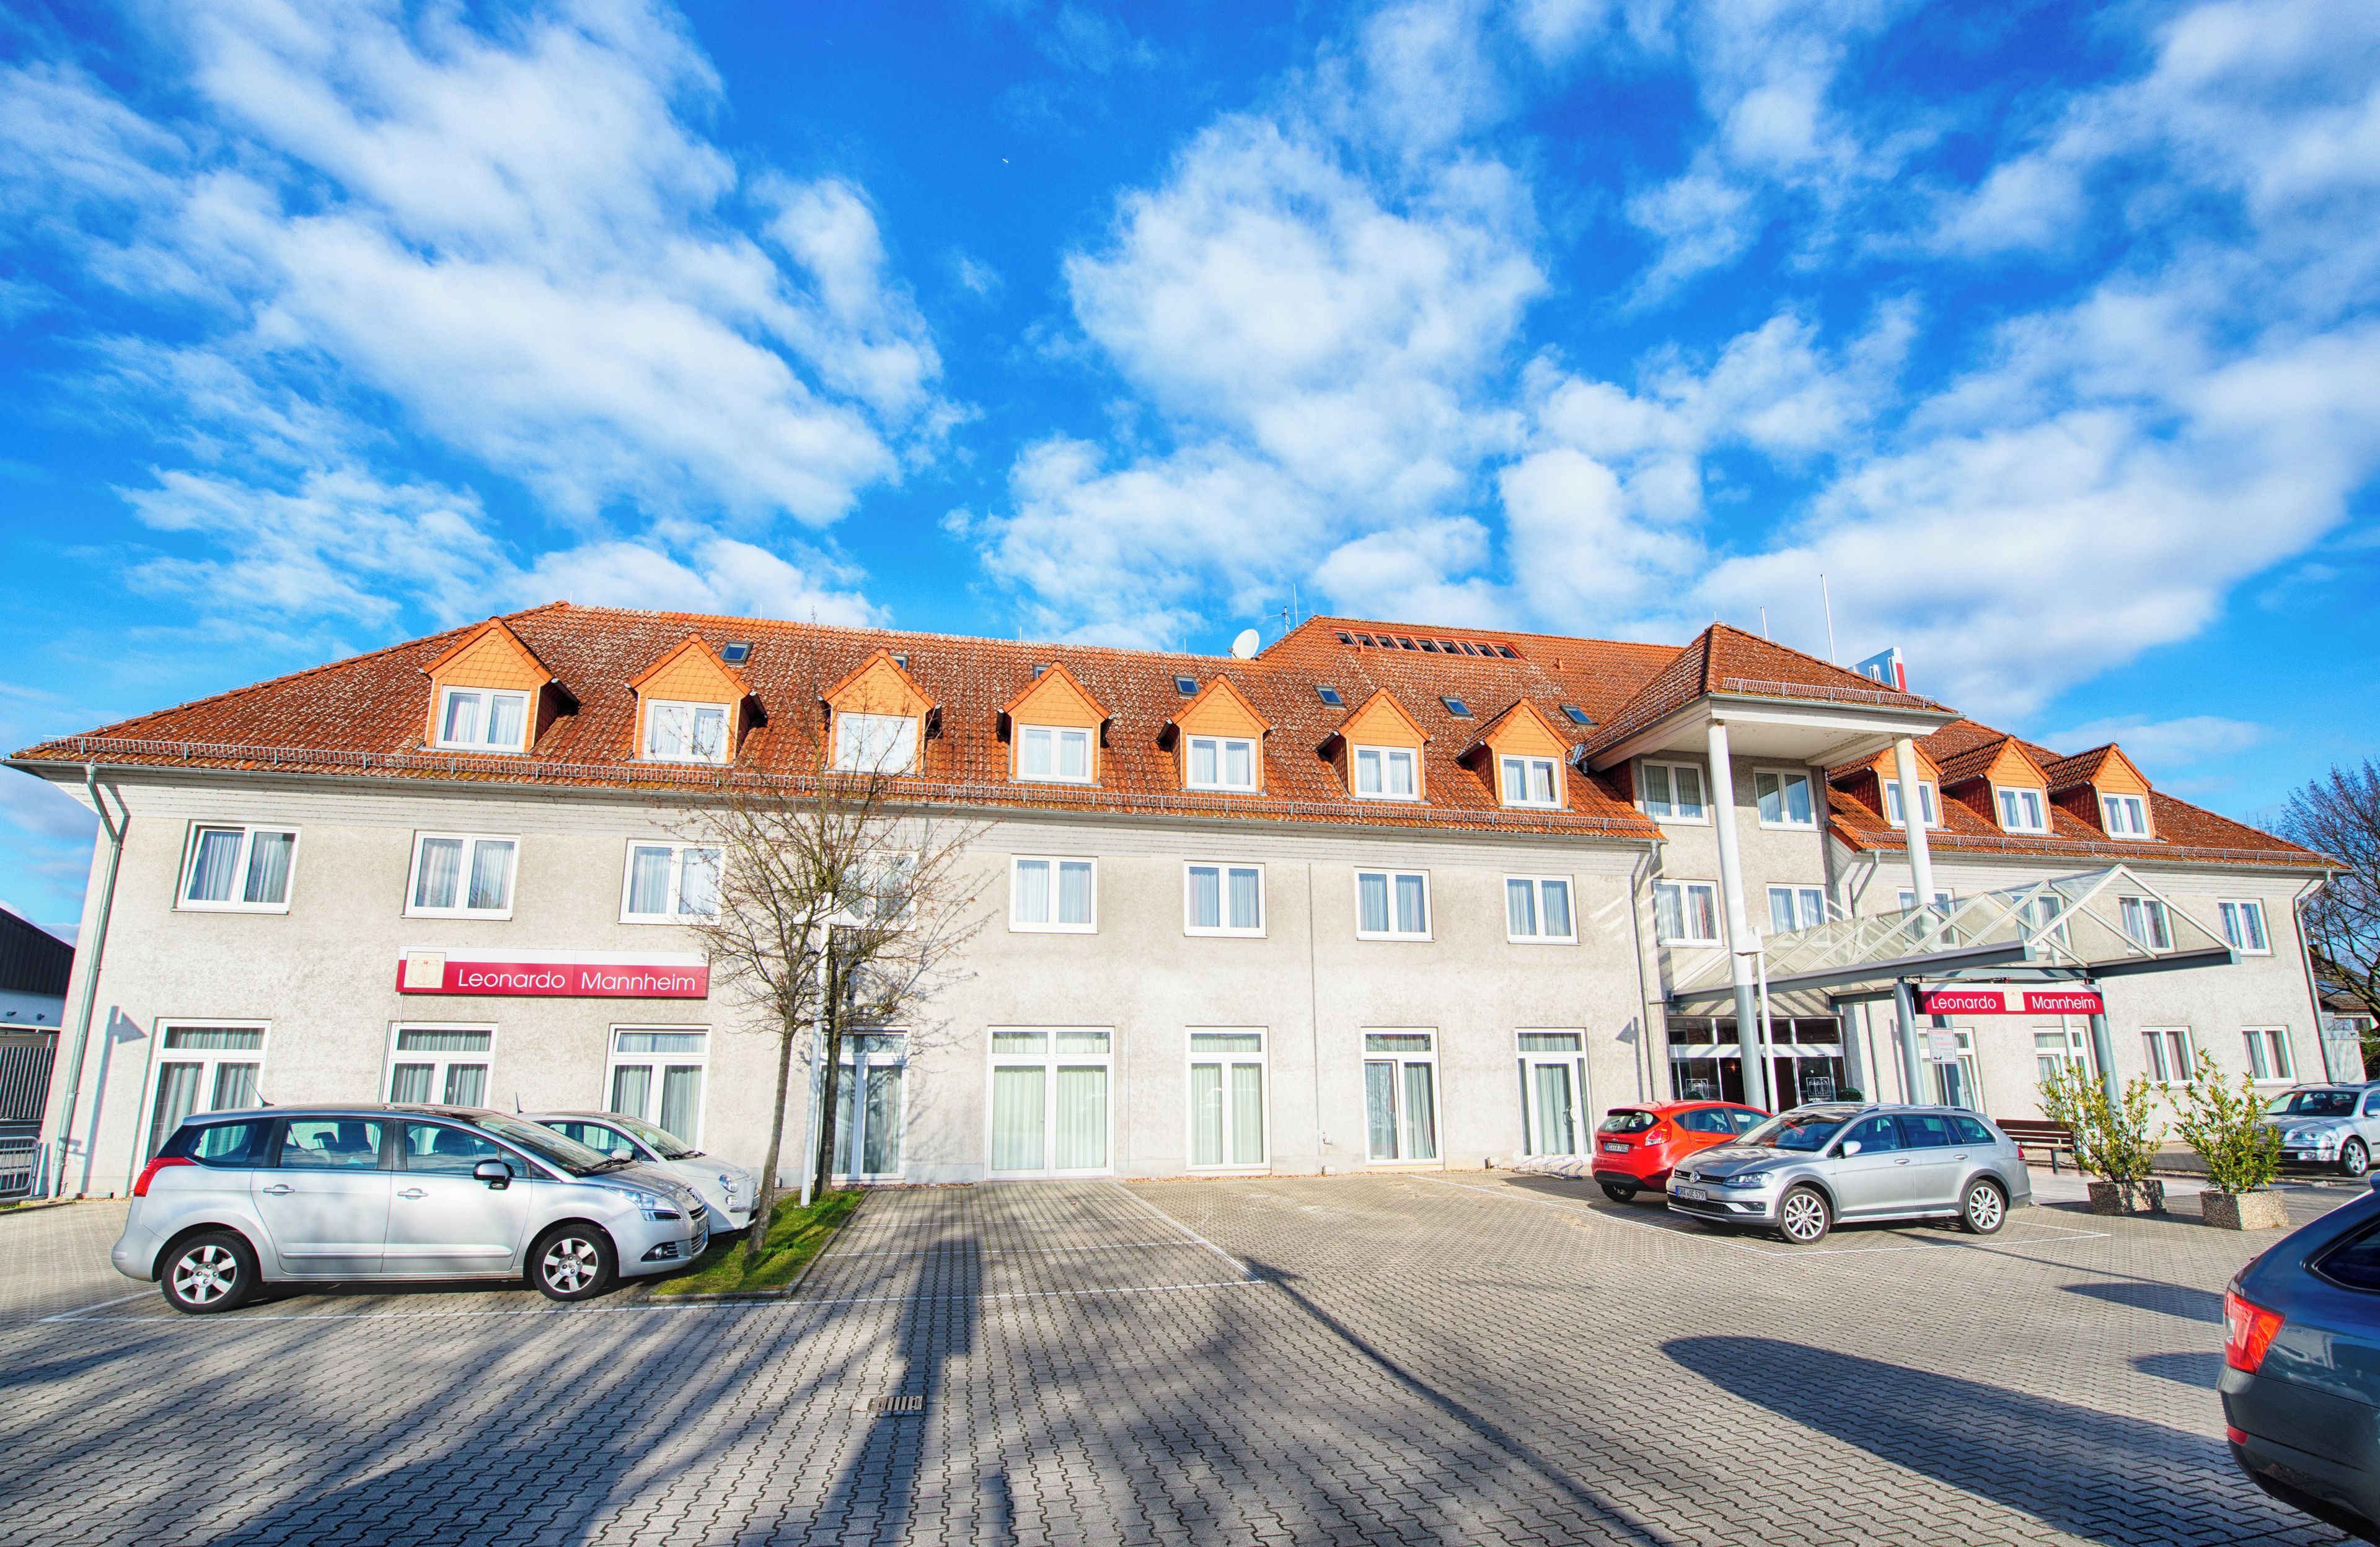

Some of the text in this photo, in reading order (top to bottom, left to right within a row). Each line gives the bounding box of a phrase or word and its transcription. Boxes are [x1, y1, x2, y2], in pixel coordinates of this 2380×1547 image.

[458, 969, 695, 991] Leonardo Mannheim
[1931, 995, 2096, 1010] Leonardo Mannheim
